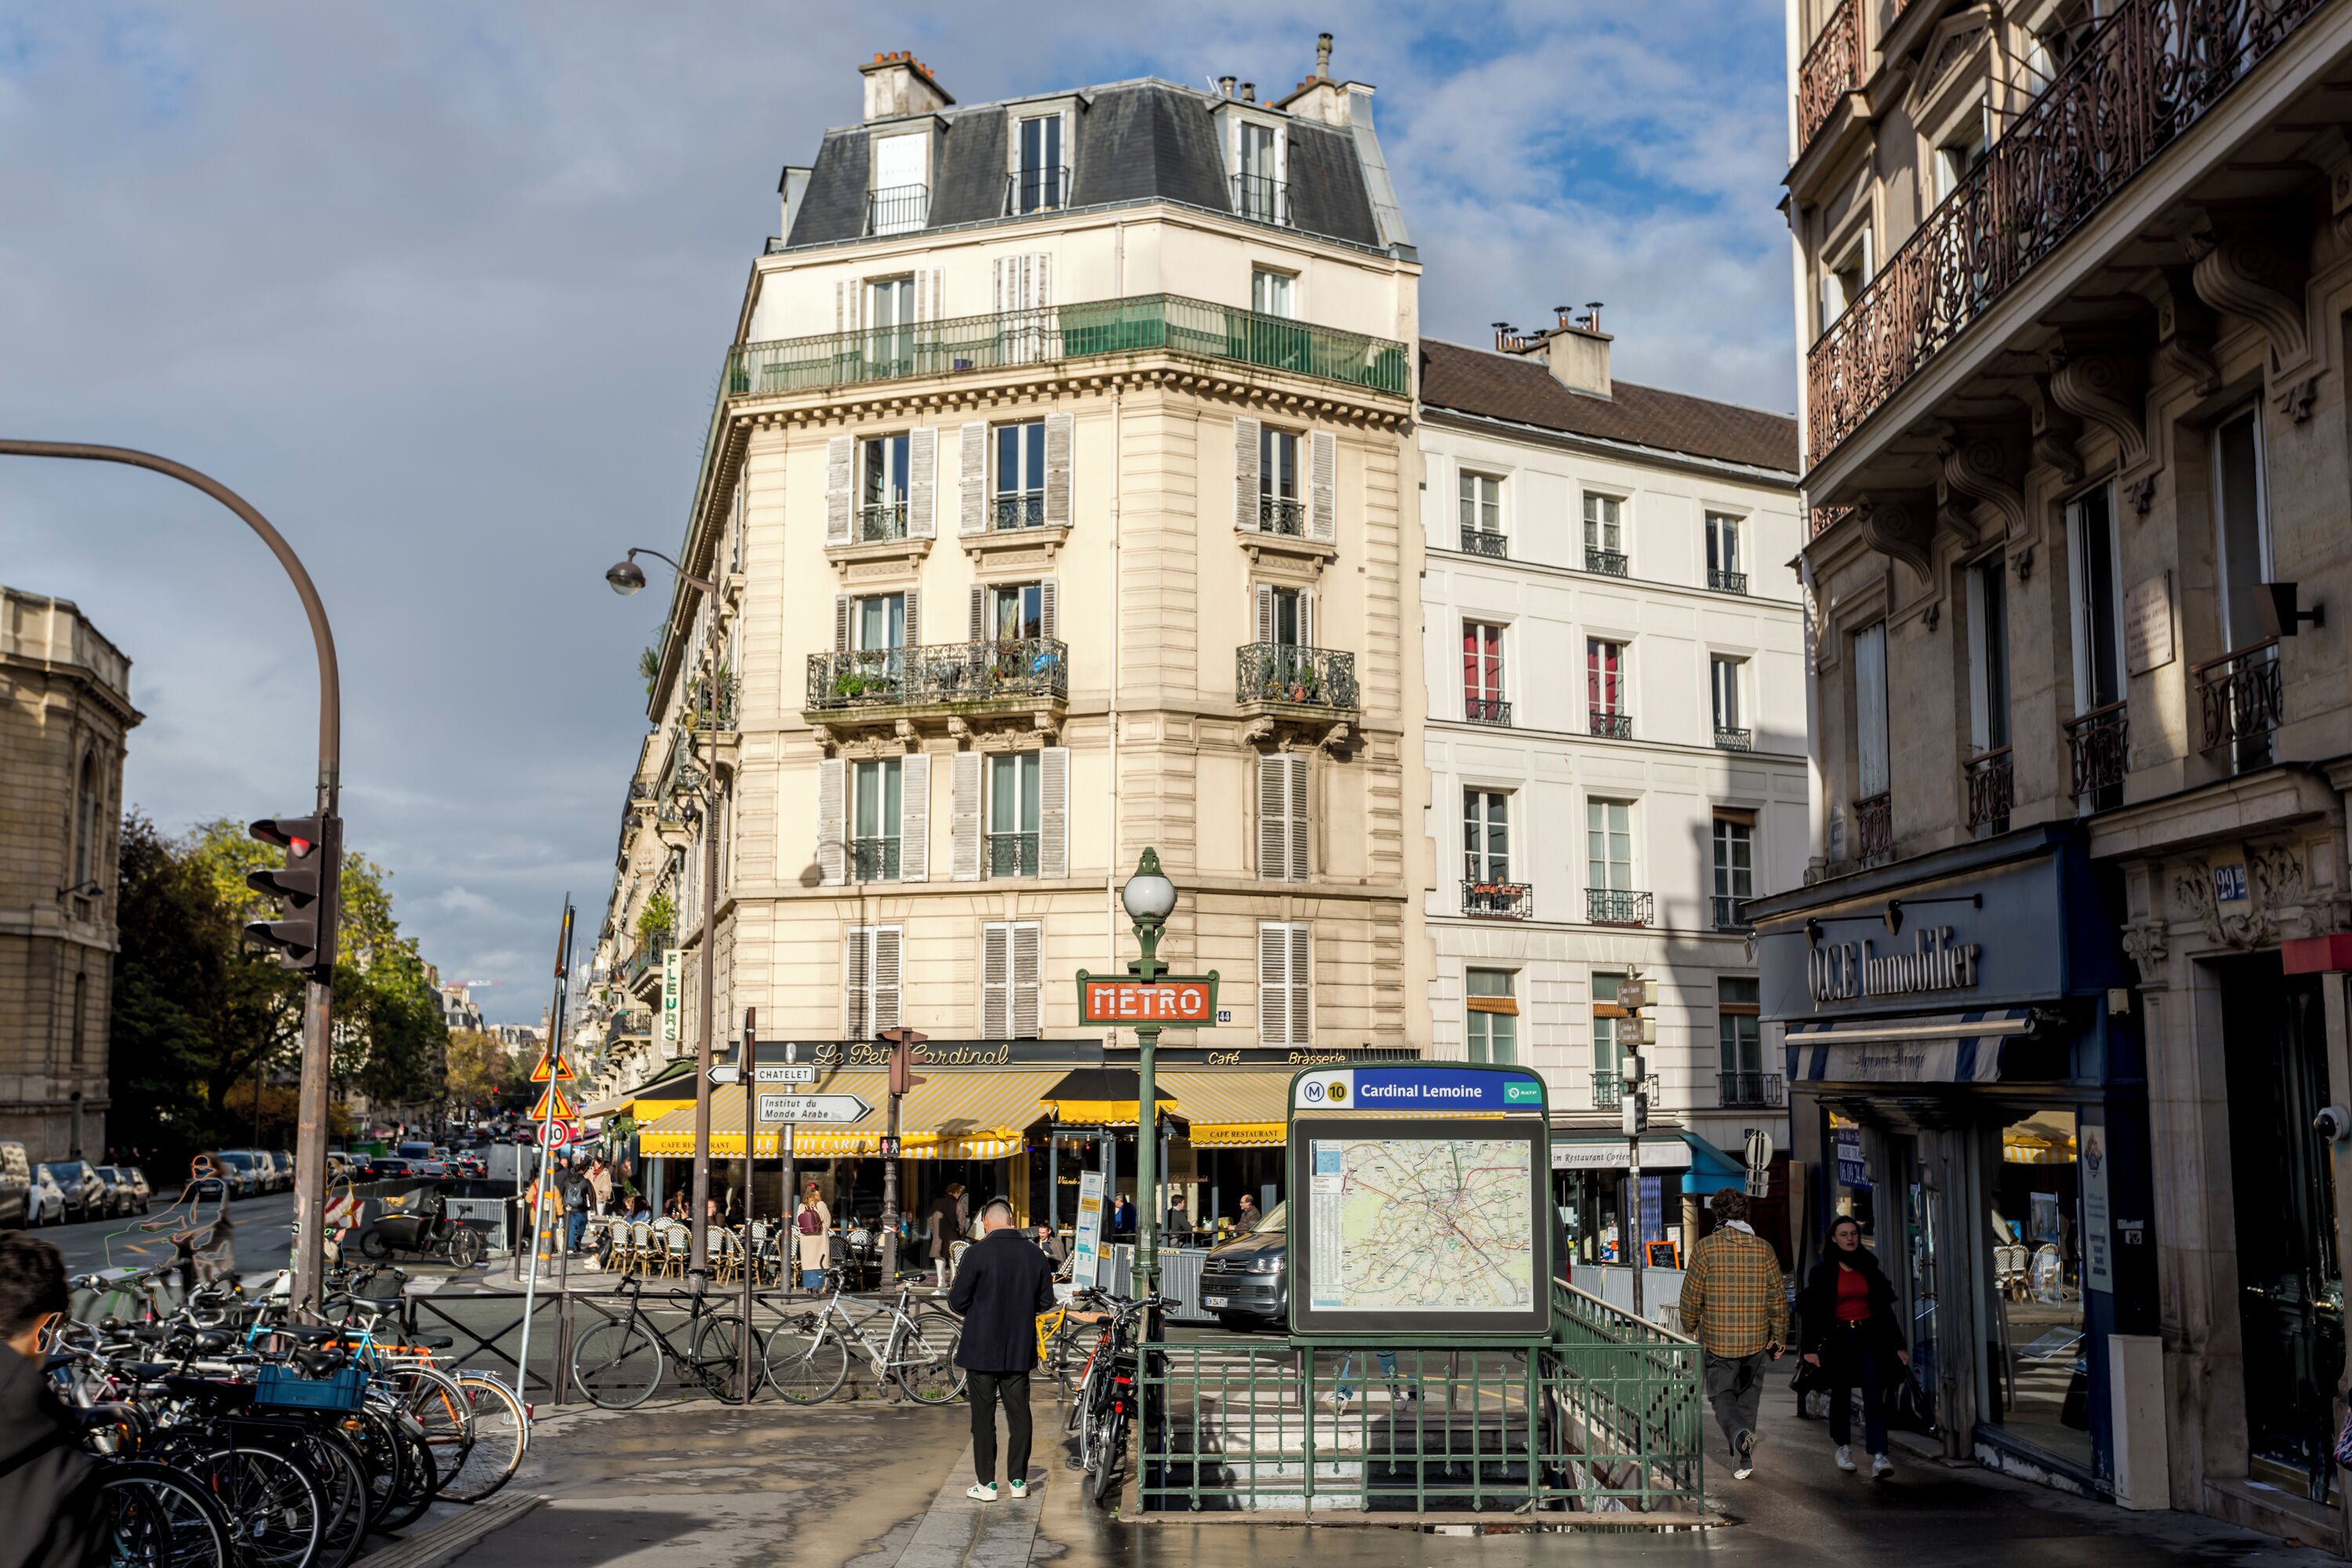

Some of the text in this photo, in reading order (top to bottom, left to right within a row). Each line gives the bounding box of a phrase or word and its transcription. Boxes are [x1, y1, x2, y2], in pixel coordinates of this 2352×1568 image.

[2216, 868, 2235, 900] 29
[1808, 924, 1981, 1002] O.C.E Immobilier
[665, 953, 677, 1041] FLEURS
[1094, 988, 1201, 1015] METRO
[1219, 1011, 1230, 1022] 44
[813, 1044, 844, 1065] Le
[849, 1043, 892, 1065] Peti
[1208, 1050, 1241, 1065] Café
[1288, 1051, 1346, 1065] Brasserie
[760, 1070, 809, 1080] CHATELET
[1308, 1086, 1345, 1098] M 10
[1361, 1083, 1483, 1098] Cardinal Lemoine
[765, 1098, 818, 1107] Institut du
[765, 1109, 829, 1118] Monde Arabe
[756, 1138, 775, 1150] LE
[821, 1138, 880, 1150] CARDIN
[1565, 1153, 1604, 1163] Restaurant
